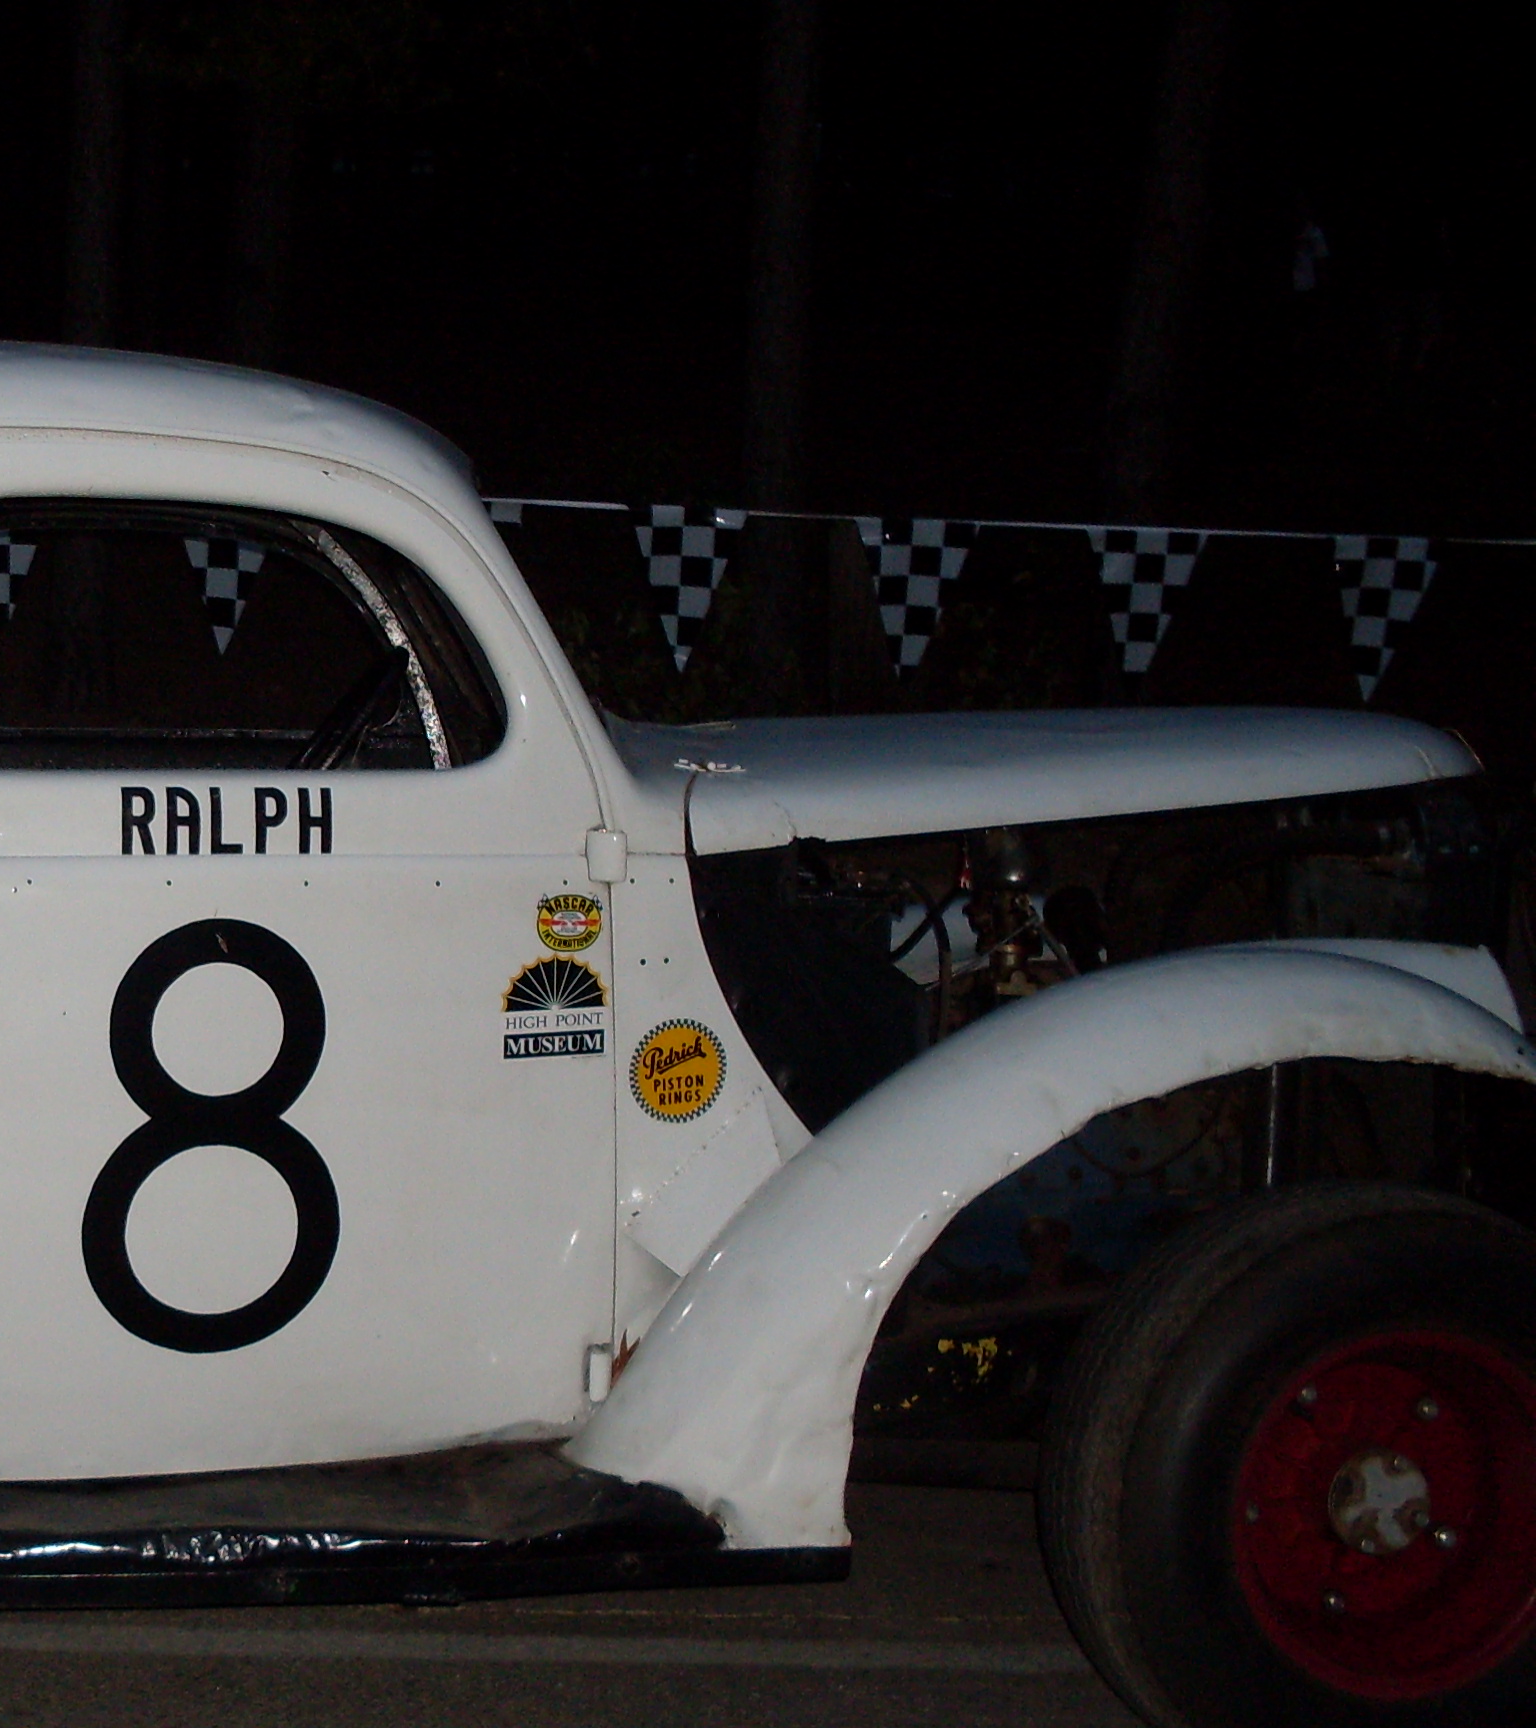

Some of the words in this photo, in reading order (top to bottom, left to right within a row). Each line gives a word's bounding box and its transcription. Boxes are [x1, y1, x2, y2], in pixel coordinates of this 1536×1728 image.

[120, 786, 333, 855] RALPH
[544, 896, 594, 916] NASCAR
[506, 1015, 547, 1030] HIGH
[556, 1012, 604, 1027] POINT
[506, 1033, 602, 1056] MUSEUM
[643, 1035, 707, 1080] Pedrick
[653, 1074, 704, 1093] PISTON
[658, 1089, 701, 1106] RINGS
[81, 918, 341, 1354] 8
